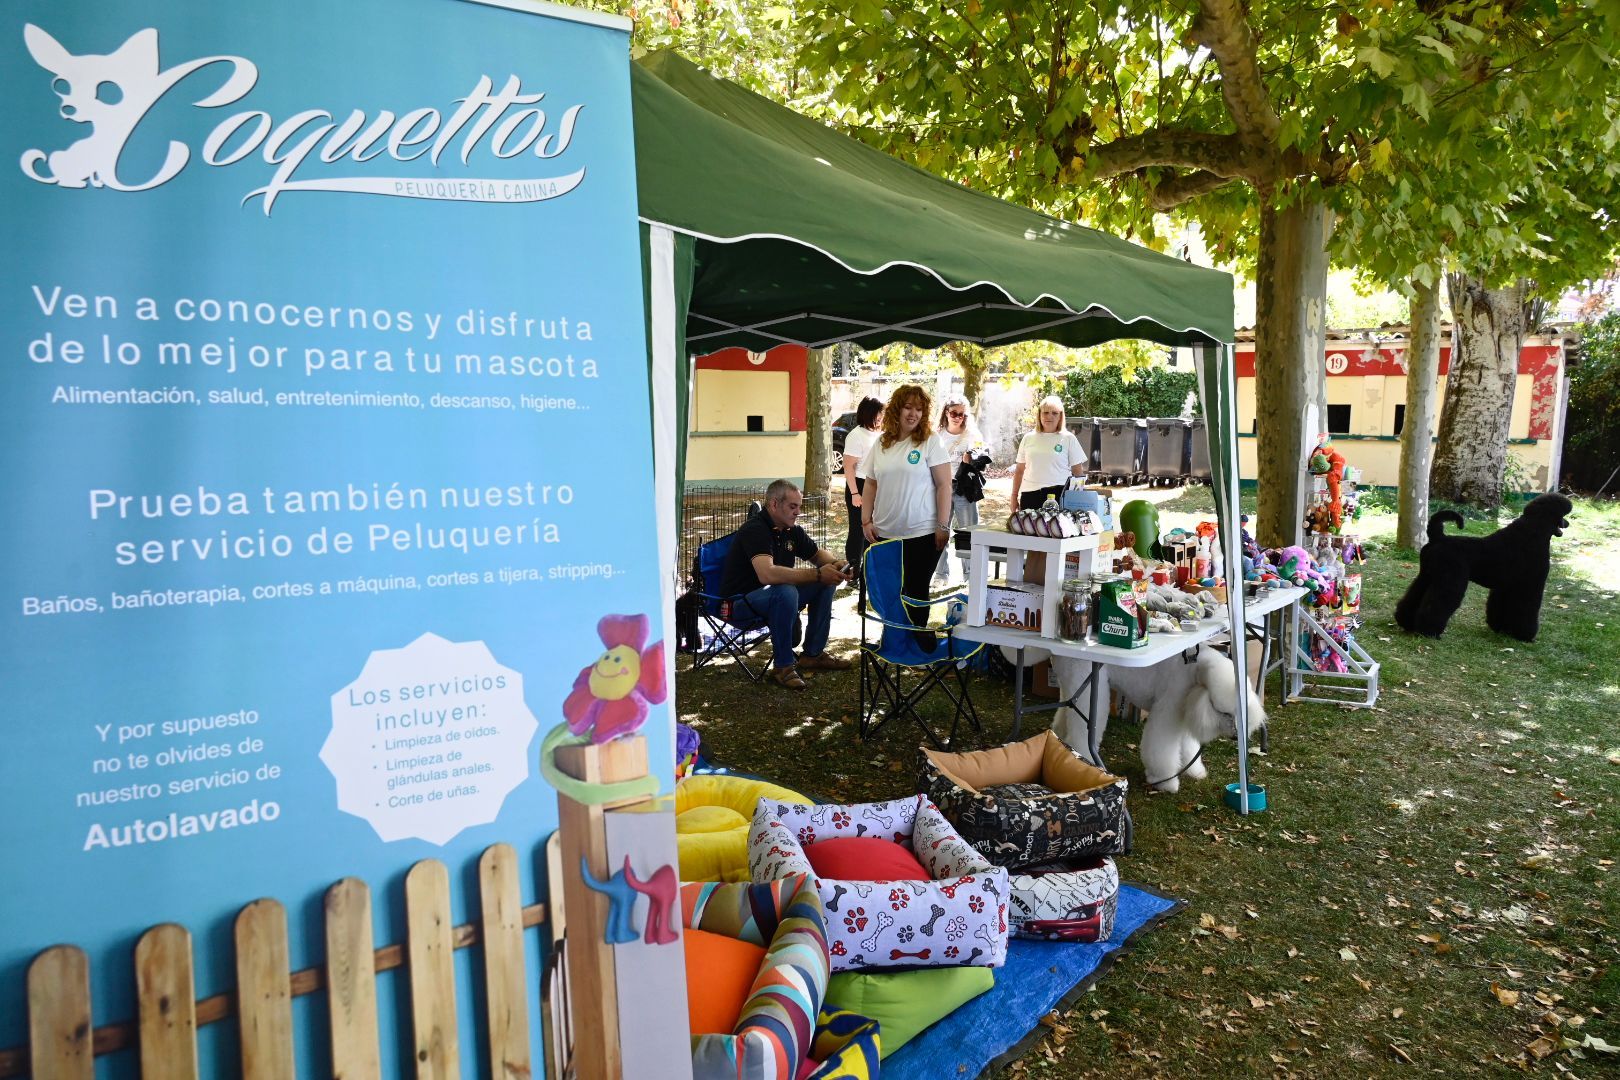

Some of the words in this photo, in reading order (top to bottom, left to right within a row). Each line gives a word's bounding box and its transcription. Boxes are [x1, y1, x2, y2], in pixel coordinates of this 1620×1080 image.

[112, 56, 586, 217] Coquettos
[395, 181, 496, 200] PELUQUERÍA
[503, 182, 558, 200] CANINA
[33, 286, 117, 318] Ven
[136, 298, 159, 320] a
[175, 299, 413, 332] conocernos
[426, 314, 441, 339] y
[456, 309, 592, 340] disfruta
[29, 333, 84, 363] de
[103, 335, 140, 365] lo
[159, 337, 288, 374] mejor
[305, 349, 394, 376] para
[406, 348, 441, 373] tu
[456, 355, 599, 378] mascota
[1330, 358, 1343, 370] 19
[52, 386, 200, 405] Alimentación,
[208, 388, 268, 406] salud,
[276, 391, 424, 408] entretenimiento,
[430, 393, 515, 410] descanso,
[521, 394, 590, 412] higiene...
[90, 486, 250, 519] Prueba
[264, 482, 427, 513] también
[441, 482, 573, 507] nuestro
[116, 529, 292, 564] servicio
[307, 527, 352, 554] de
[369, 518, 560, 553] Peluquería
[23, 596, 103, 615] Baños,
[112, 585, 246, 608] bañoterapia,
[253, 582, 314, 599] cortes
[320, 582, 331, 594] a
[337, 572, 421, 594] máquina,
[427, 572, 479, 587] cortes
[484, 572, 494, 583] a
[499, 568, 543, 584] tijera,
[549, 562, 624, 581] stripping...
[1103, 624, 1127, 636] Churu
[350, 689, 391, 707] Los
[399, 674, 507, 701] servicios
[95, 724, 112, 742] Y
[118, 723, 156, 744] por
[161, 709, 259, 736] supuesto
[376, 704, 487, 731] incluyen:
[93, 757, 121, 774] no
[128, 753, 149, 770] te
[155, 742, 232, 767] olvides
[238, 736, 264, 754] de
[385, 732, 442, 752] Limpieza
[445, 730, 461, 743] de
[386, 752, 444, 772] Limpieza
[447, 750, 463, 763] de
[387, 768, 448, 791] glándulas
[452, 761, 495, 778] anales.
[76, 782, 162, 807] nuestro
[168, 768, 250, 795] servicio
[255, 763, 281, 781] de
[388, 793, 424, 809] Corte
[427, 789, 443, 802] de
[447, 784, 480, 799] uñas.
[82, 798, 281, 851] Autolavado
[1019, 831, 1035, 861] Pooch
